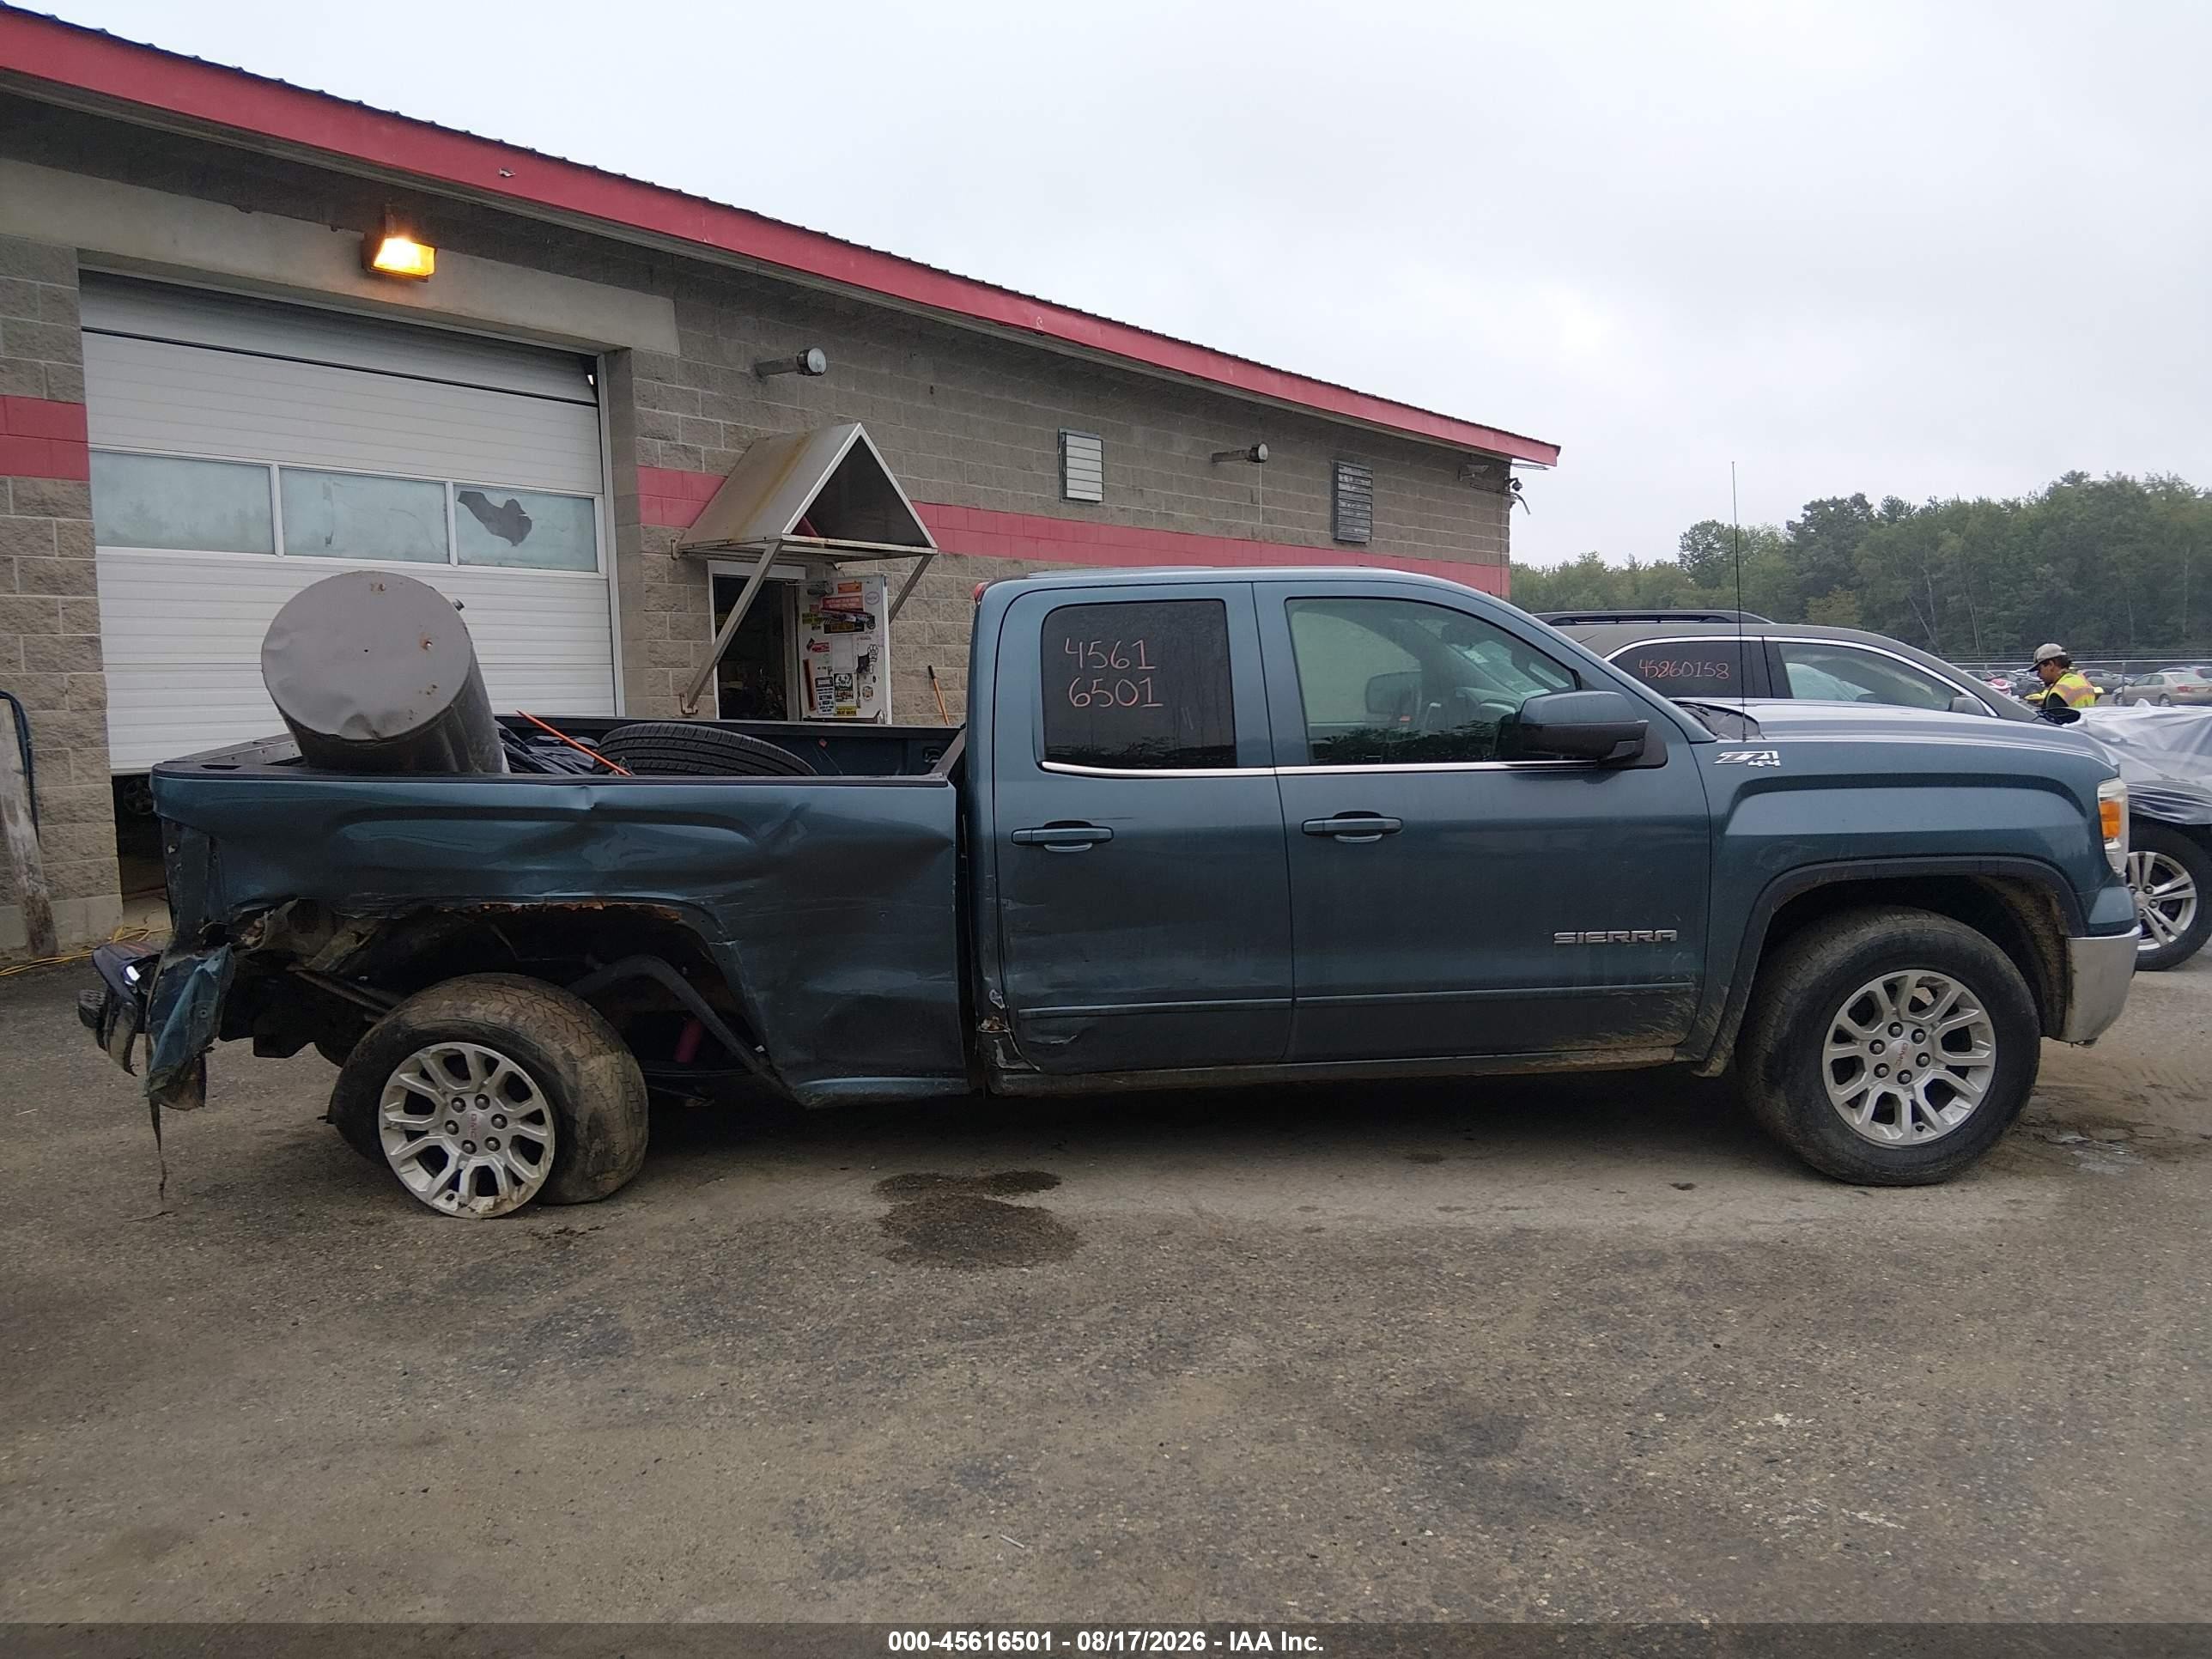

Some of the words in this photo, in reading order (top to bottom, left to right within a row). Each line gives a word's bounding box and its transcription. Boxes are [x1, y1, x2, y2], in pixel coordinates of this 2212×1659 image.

[1065, 637, 1156, 669] 4561
[1068, 677, 1164, 708] 6501
[1553, 929, 1677, 945] SIERRA
